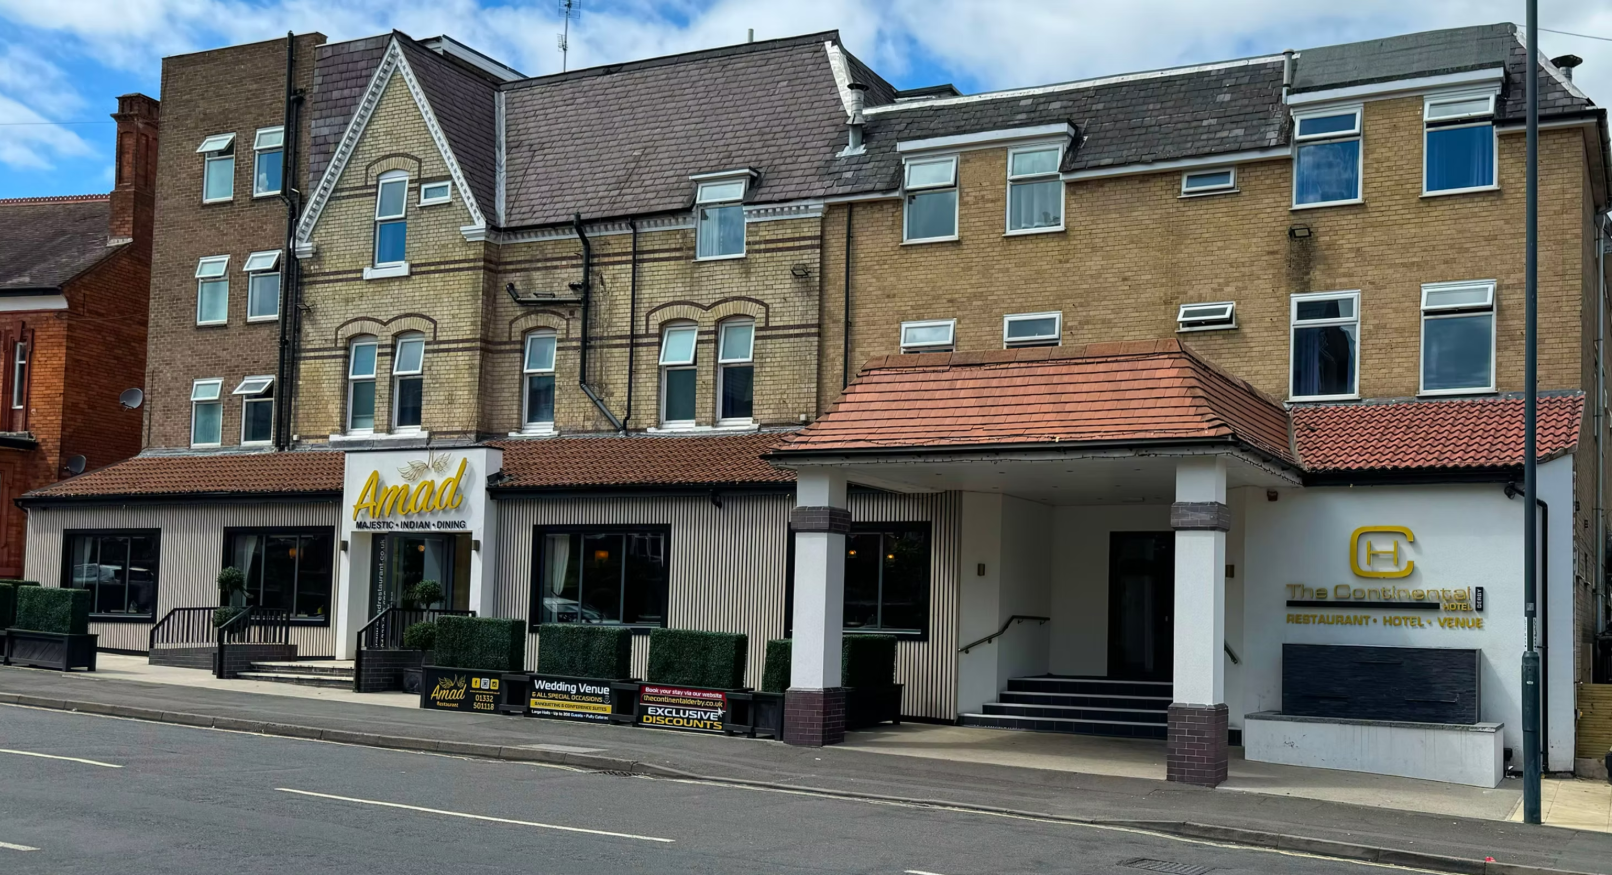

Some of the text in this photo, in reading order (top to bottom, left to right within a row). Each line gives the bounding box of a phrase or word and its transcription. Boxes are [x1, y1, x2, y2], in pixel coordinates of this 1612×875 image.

[353, 457, 467, 521] Amad
[356, 520, 467, 529] MAJESTIC INDIAN DINING
[1286, 584, 1471, 600] The Continental
[1443, 602, 1473, 611] HOTEL
[1286, 614, 1484, 629] RESTAURANT HOTEL VENUE
[430, 684, 467, 700] Amad
[534, 680, 610, 695] Wedding Venue
[475, 694, 494, 702] 01332
[571, 695, 603, 703] OCCASIONS
[643, 694, 723, 707] thecontinentalderby.co.uk
[473, 702, 495, 710] 501118
[647, 707, 718, 720] EXCLUSIVE
[643, 715, 722, 730] DISCOUNTS
